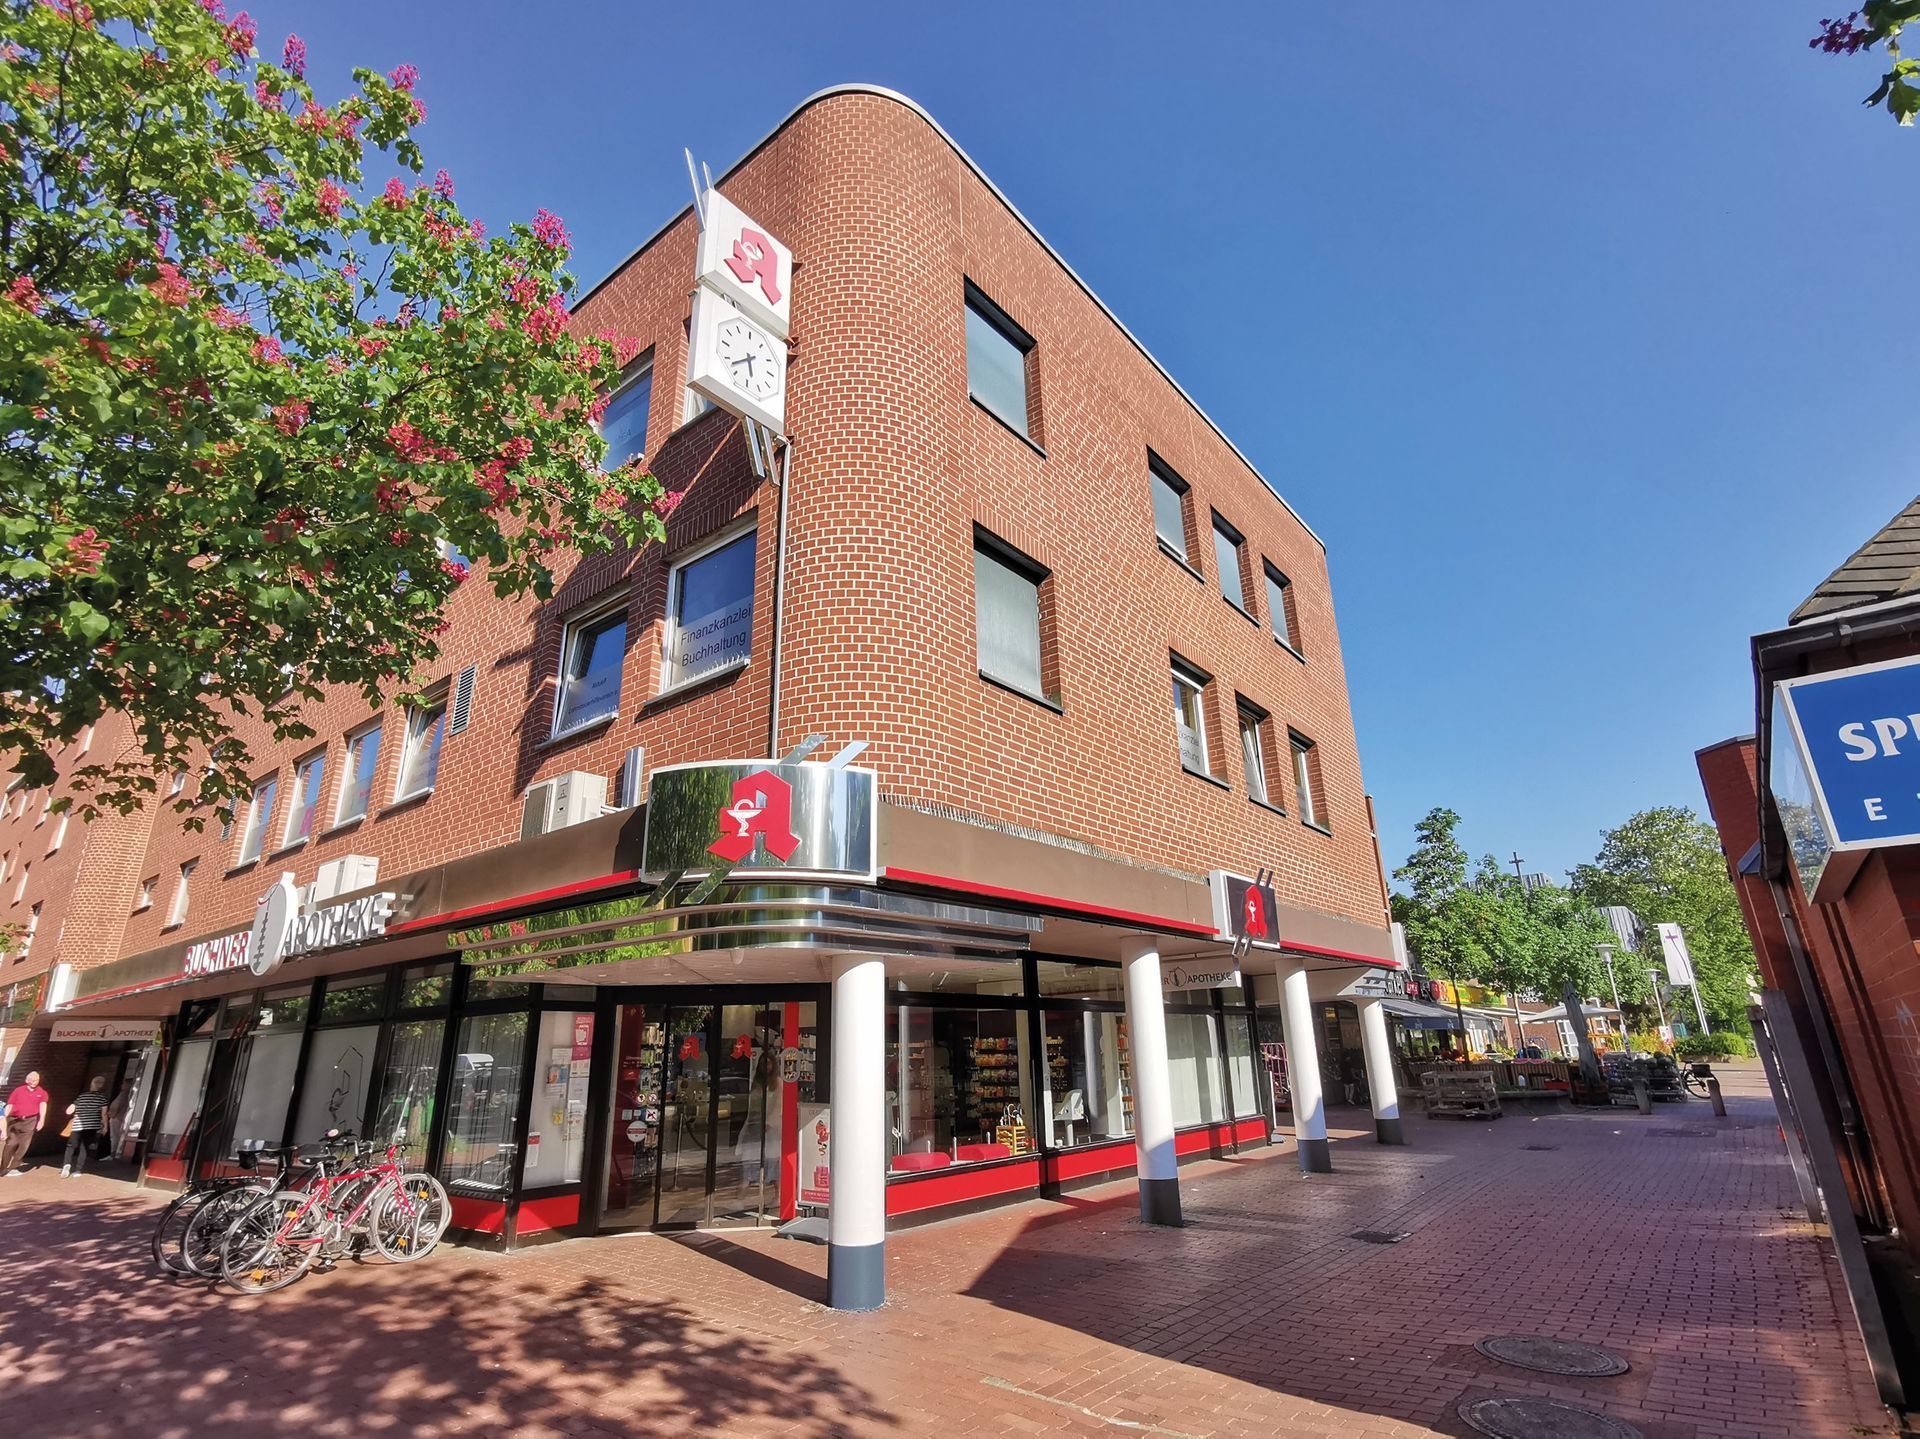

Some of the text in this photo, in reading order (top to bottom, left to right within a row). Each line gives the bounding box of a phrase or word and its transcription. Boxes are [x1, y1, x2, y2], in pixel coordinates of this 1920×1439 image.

[680, 603, 752, 646] Finanzkanzlei
[681, 631, 747, 667] Buchhaltung
[182, 891, 396, 979] BUCHNER APOTHEKE
[1187, 971, 1232, 984] APOTHEKE
[56, 1029, 154, 1038] BUCHNER APOTHEKE
